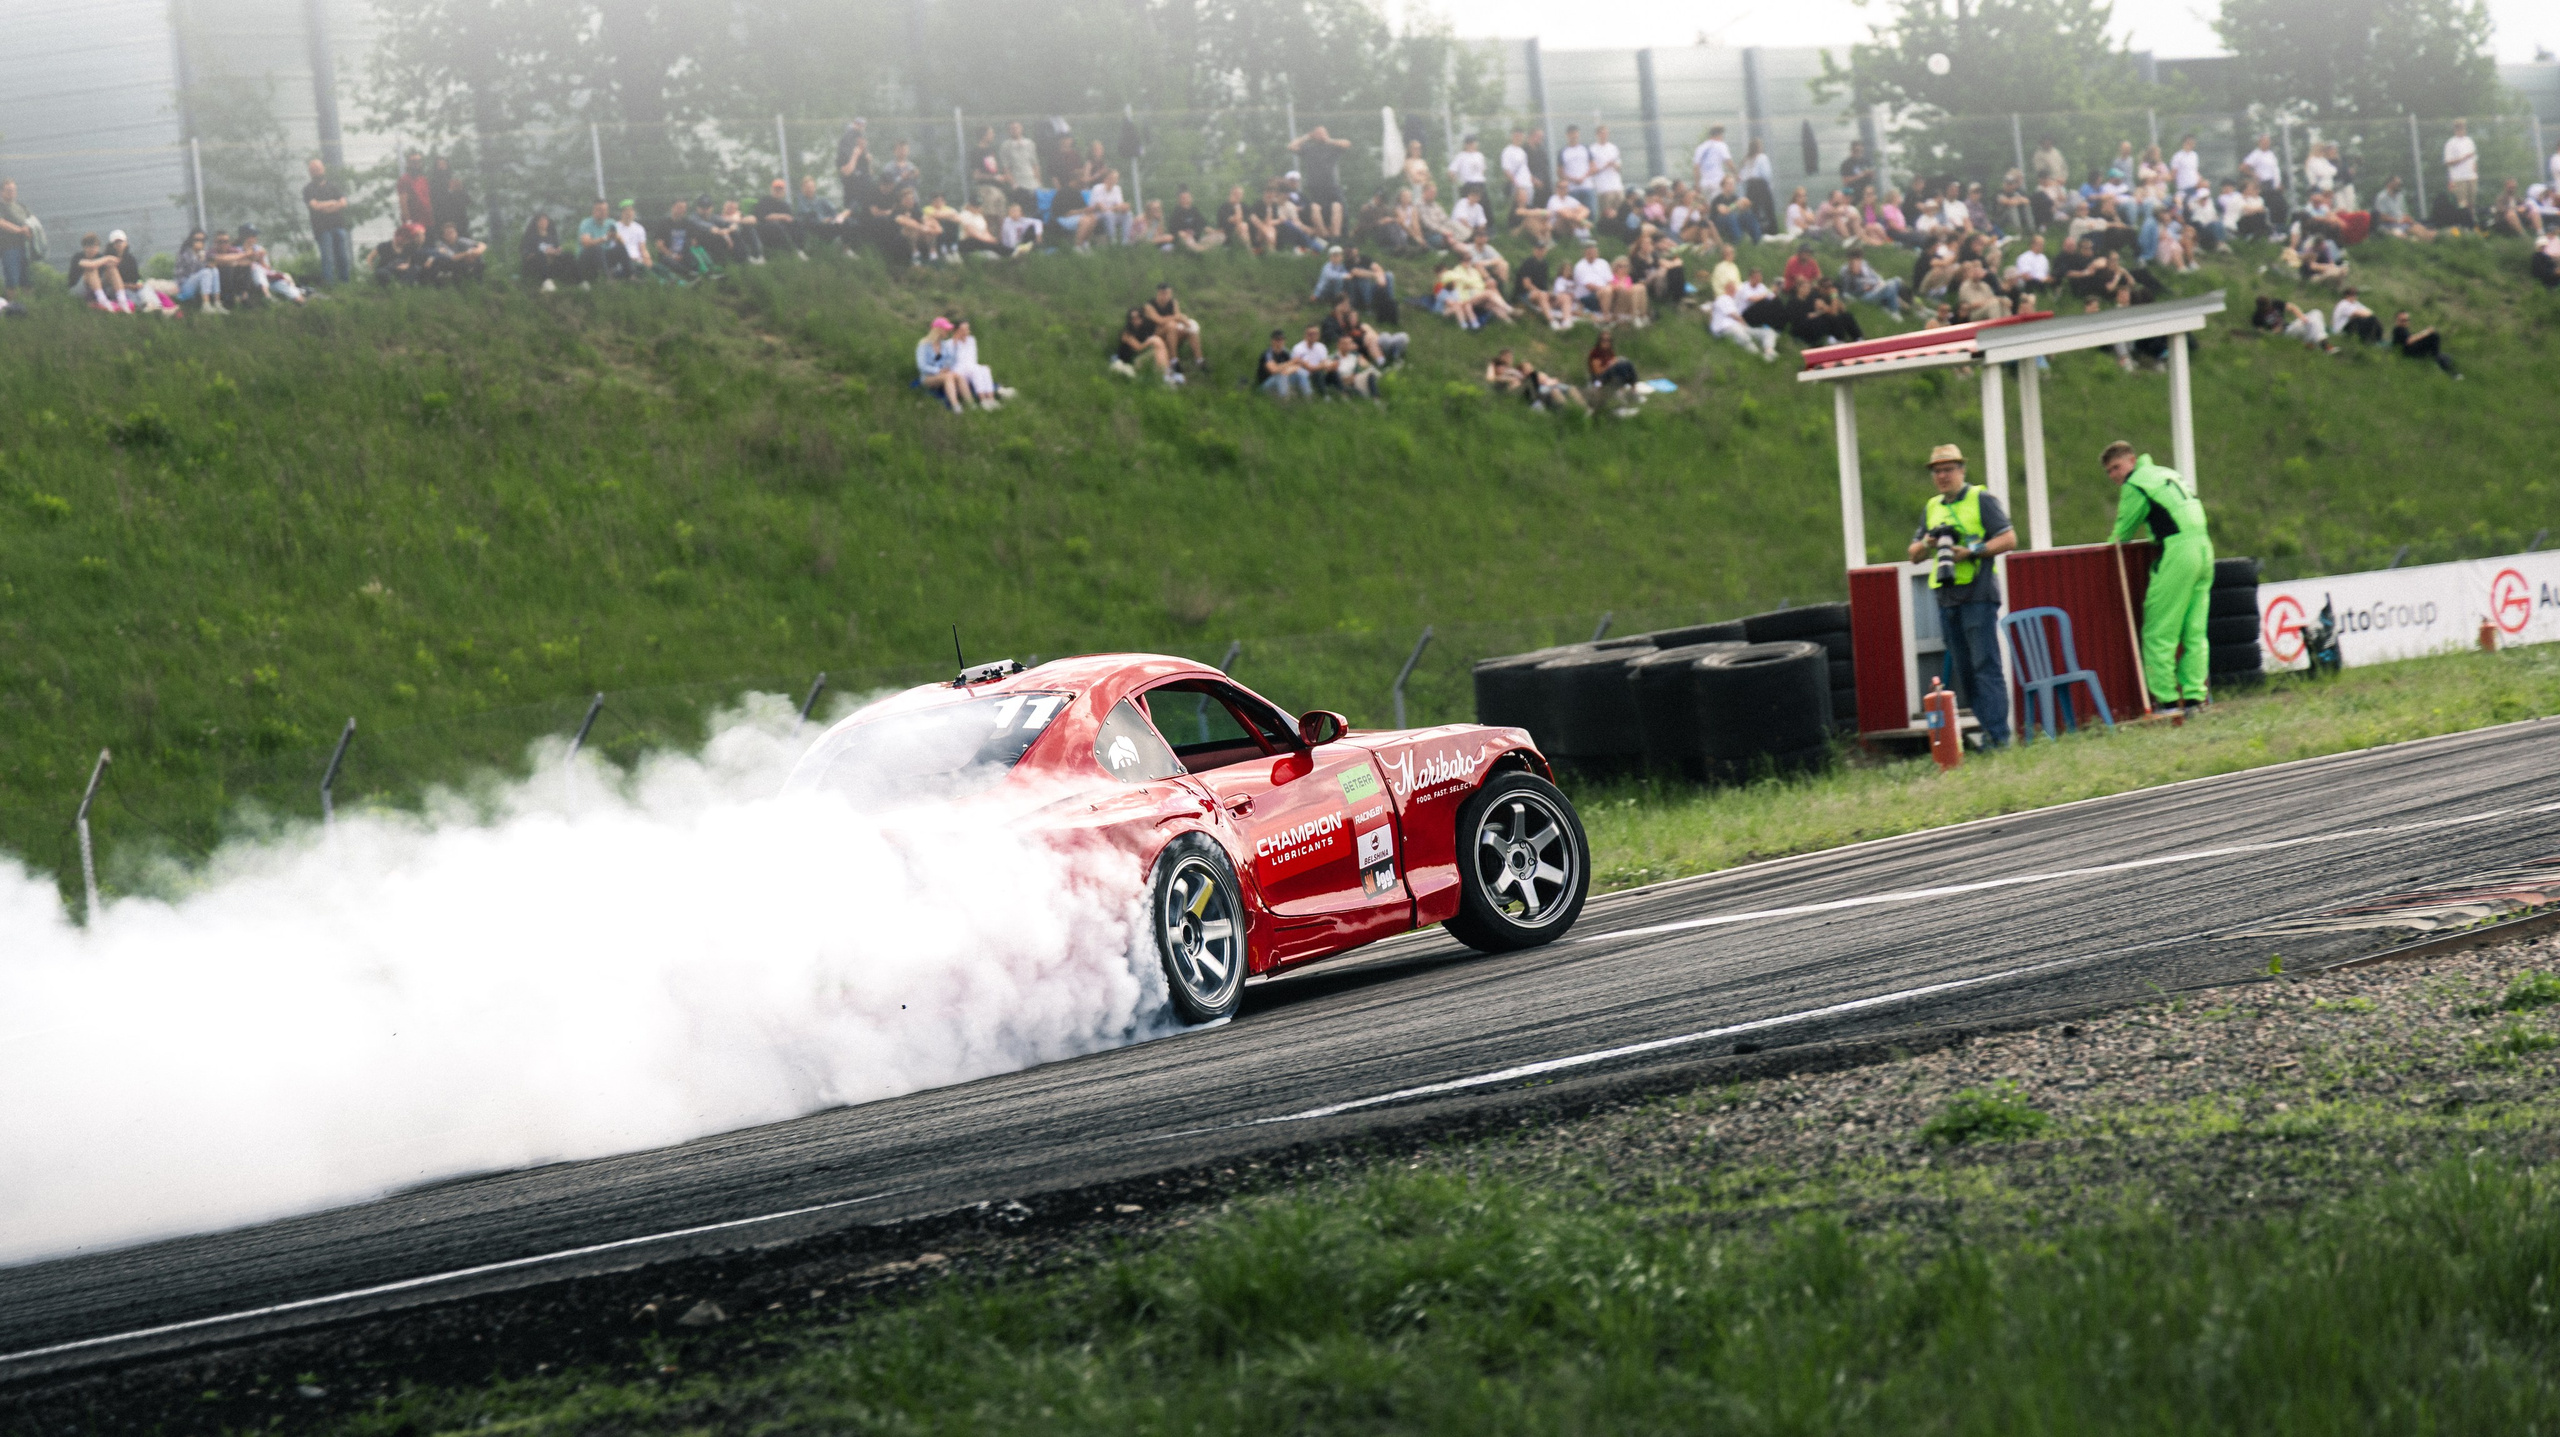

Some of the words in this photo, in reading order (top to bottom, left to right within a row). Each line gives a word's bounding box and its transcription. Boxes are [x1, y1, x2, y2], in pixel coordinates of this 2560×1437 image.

[2337, 600, 2438, 634] utoGroup
[993, 694, 1064, 729] 11
[1378, 745, 1486, 796] Marikaro
[1449, 781, 1473, 793] SELECT
[1256, 811, 1343, 858] CHAMPION
[1271, 836, 1334, 866] LUBRICANTS
[1364, 848, 1390, 866] BELSHINA
